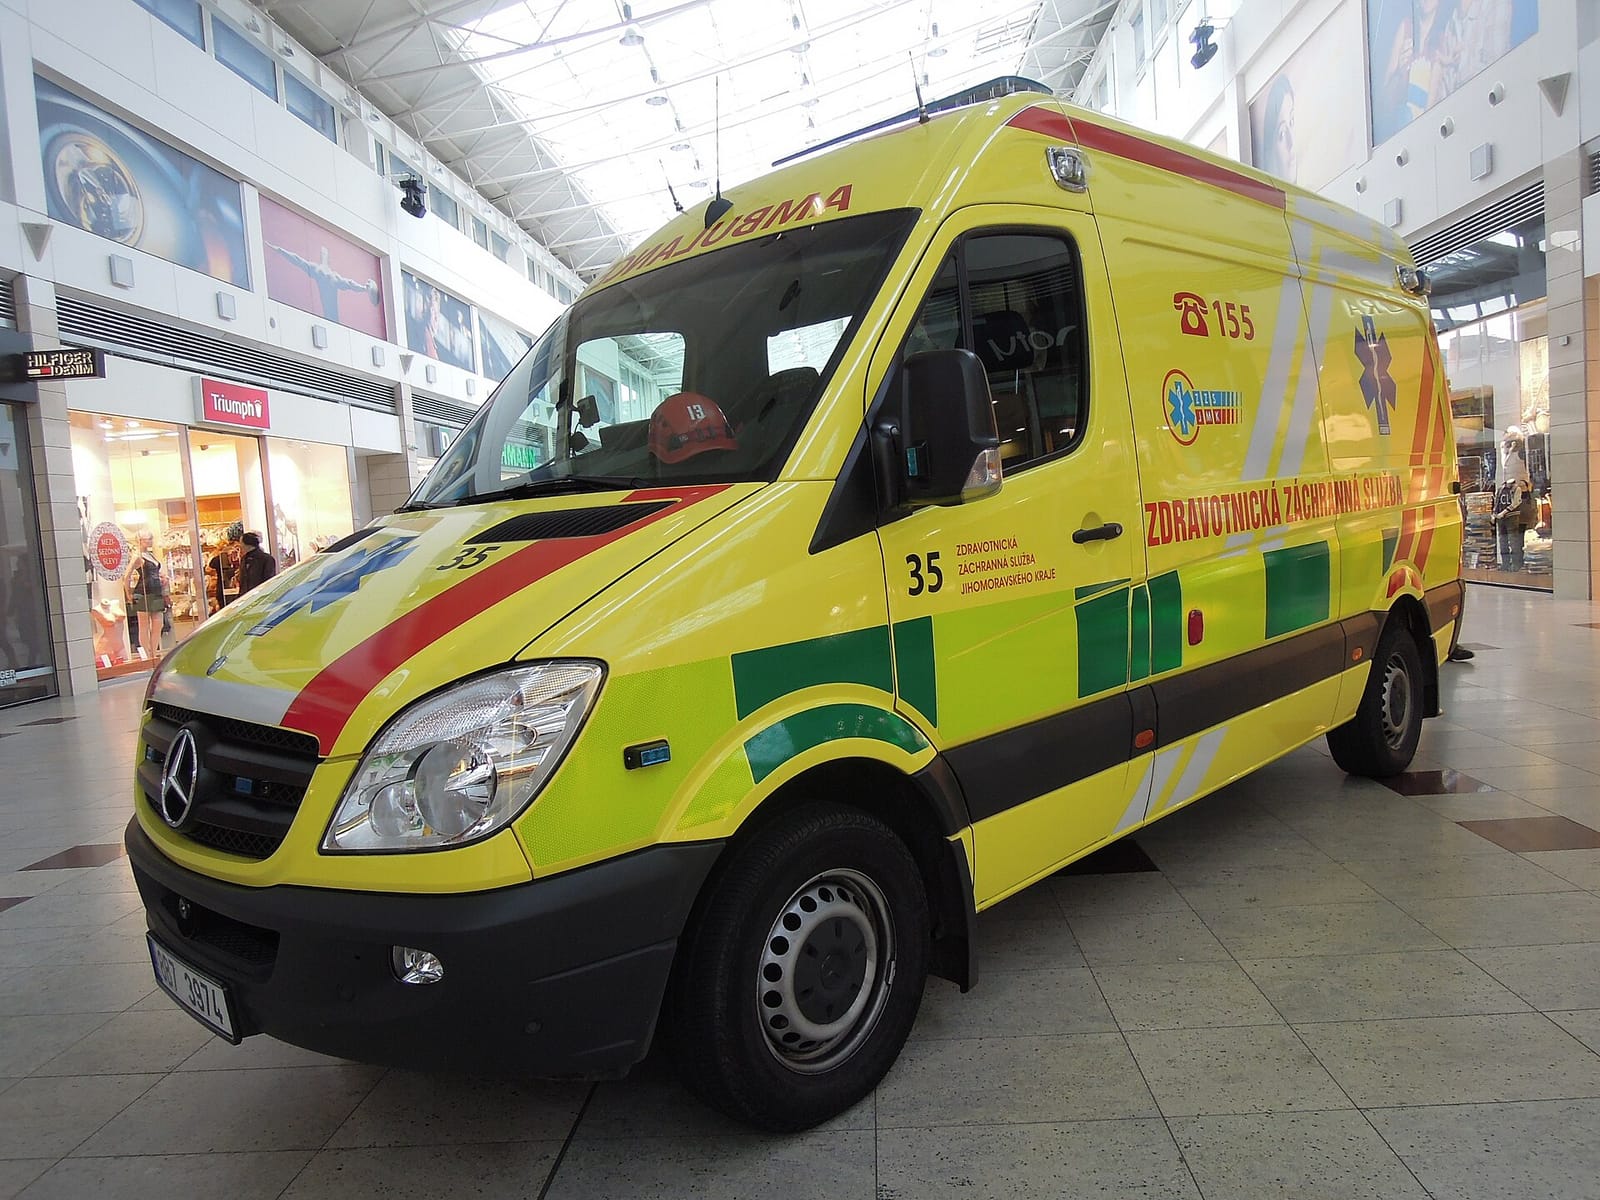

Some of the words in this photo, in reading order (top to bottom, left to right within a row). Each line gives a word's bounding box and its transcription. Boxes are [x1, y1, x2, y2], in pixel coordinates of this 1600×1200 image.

[1212, 300, 1255, 341] 155
[28, 352, 92, 367] HILFIGER
[54, 364, 94, 376] DENIM
[210, 392, 255, 420] Triumph
[1145, 480, 1281, 547] ZDRAVOTNICKÁ
[1283, 473, 1361, 524] ZÁCHRANNÁ
[1363, 470, 1403, 510] SLUŽBA
[436, 546, 501, 571] 35
[956, 535, 1018, 557] ZDRAVOTNICKÁ
[905, 551, 944, 597] 35
[958, 554, 1008, 576] ZÁCHRANNÁ
[1010, 552, 1036, 567] SLUŽBA
[961, 569, 1033, 595] JIHOMORAVSKÉHO
[1035, 568, 1056, 582] KRAJE
[184, 972, 224, 1025] 3974
